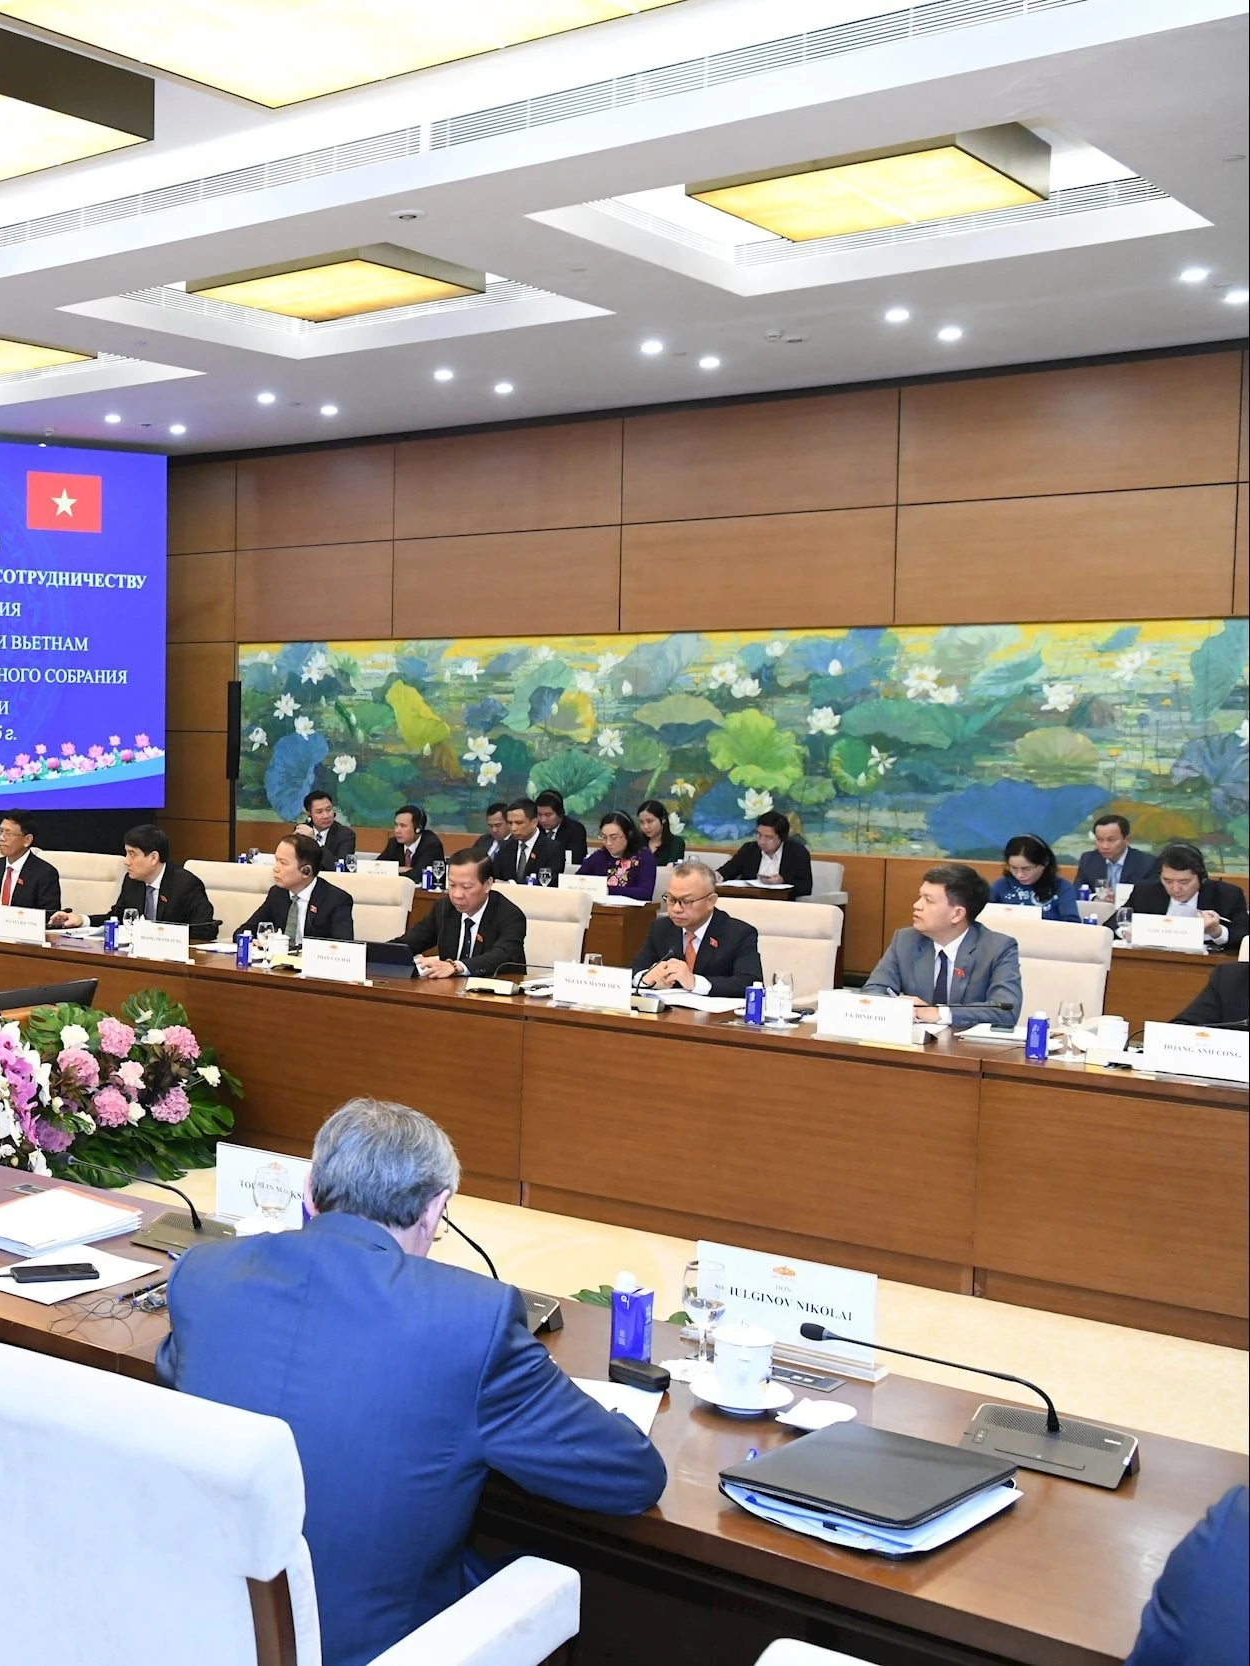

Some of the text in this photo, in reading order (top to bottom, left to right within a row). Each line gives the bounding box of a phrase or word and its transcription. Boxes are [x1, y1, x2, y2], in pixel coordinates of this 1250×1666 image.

[10, 634, 89, 652] ВЬЕТНАМ
[44, 668, 128, 685] СОБРАНИЯ
[4, 728, 17, 741] г.
[1163, 1043, 1194, 1054] HOANG
[1197, 1048, 1215, 1056] ANH
[796, 1300, 853, 1322] NIKOLAI
